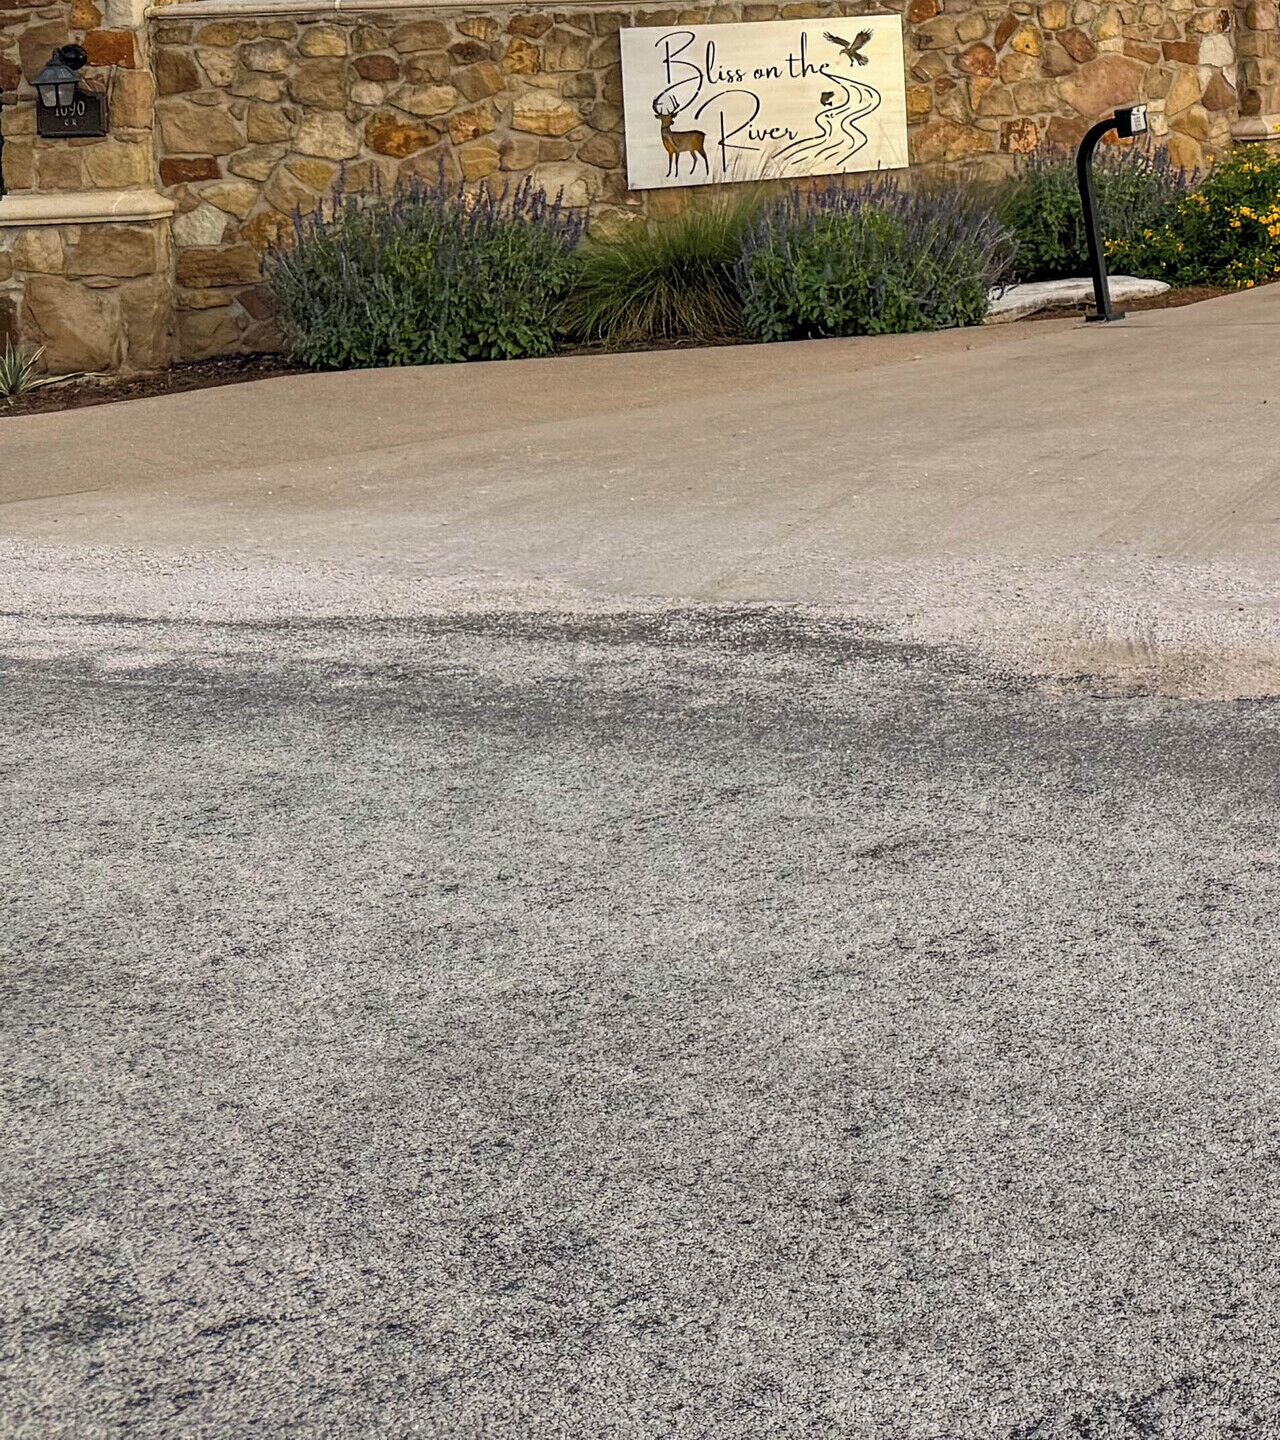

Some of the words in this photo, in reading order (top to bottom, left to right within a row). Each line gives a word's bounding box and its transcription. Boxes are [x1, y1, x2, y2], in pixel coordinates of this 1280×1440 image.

[653, 30, 746, 110] Bliss
[753, 64, 784, 80] on
[785, 31, 830, 79] the
[694, 89, 799, 172] River
